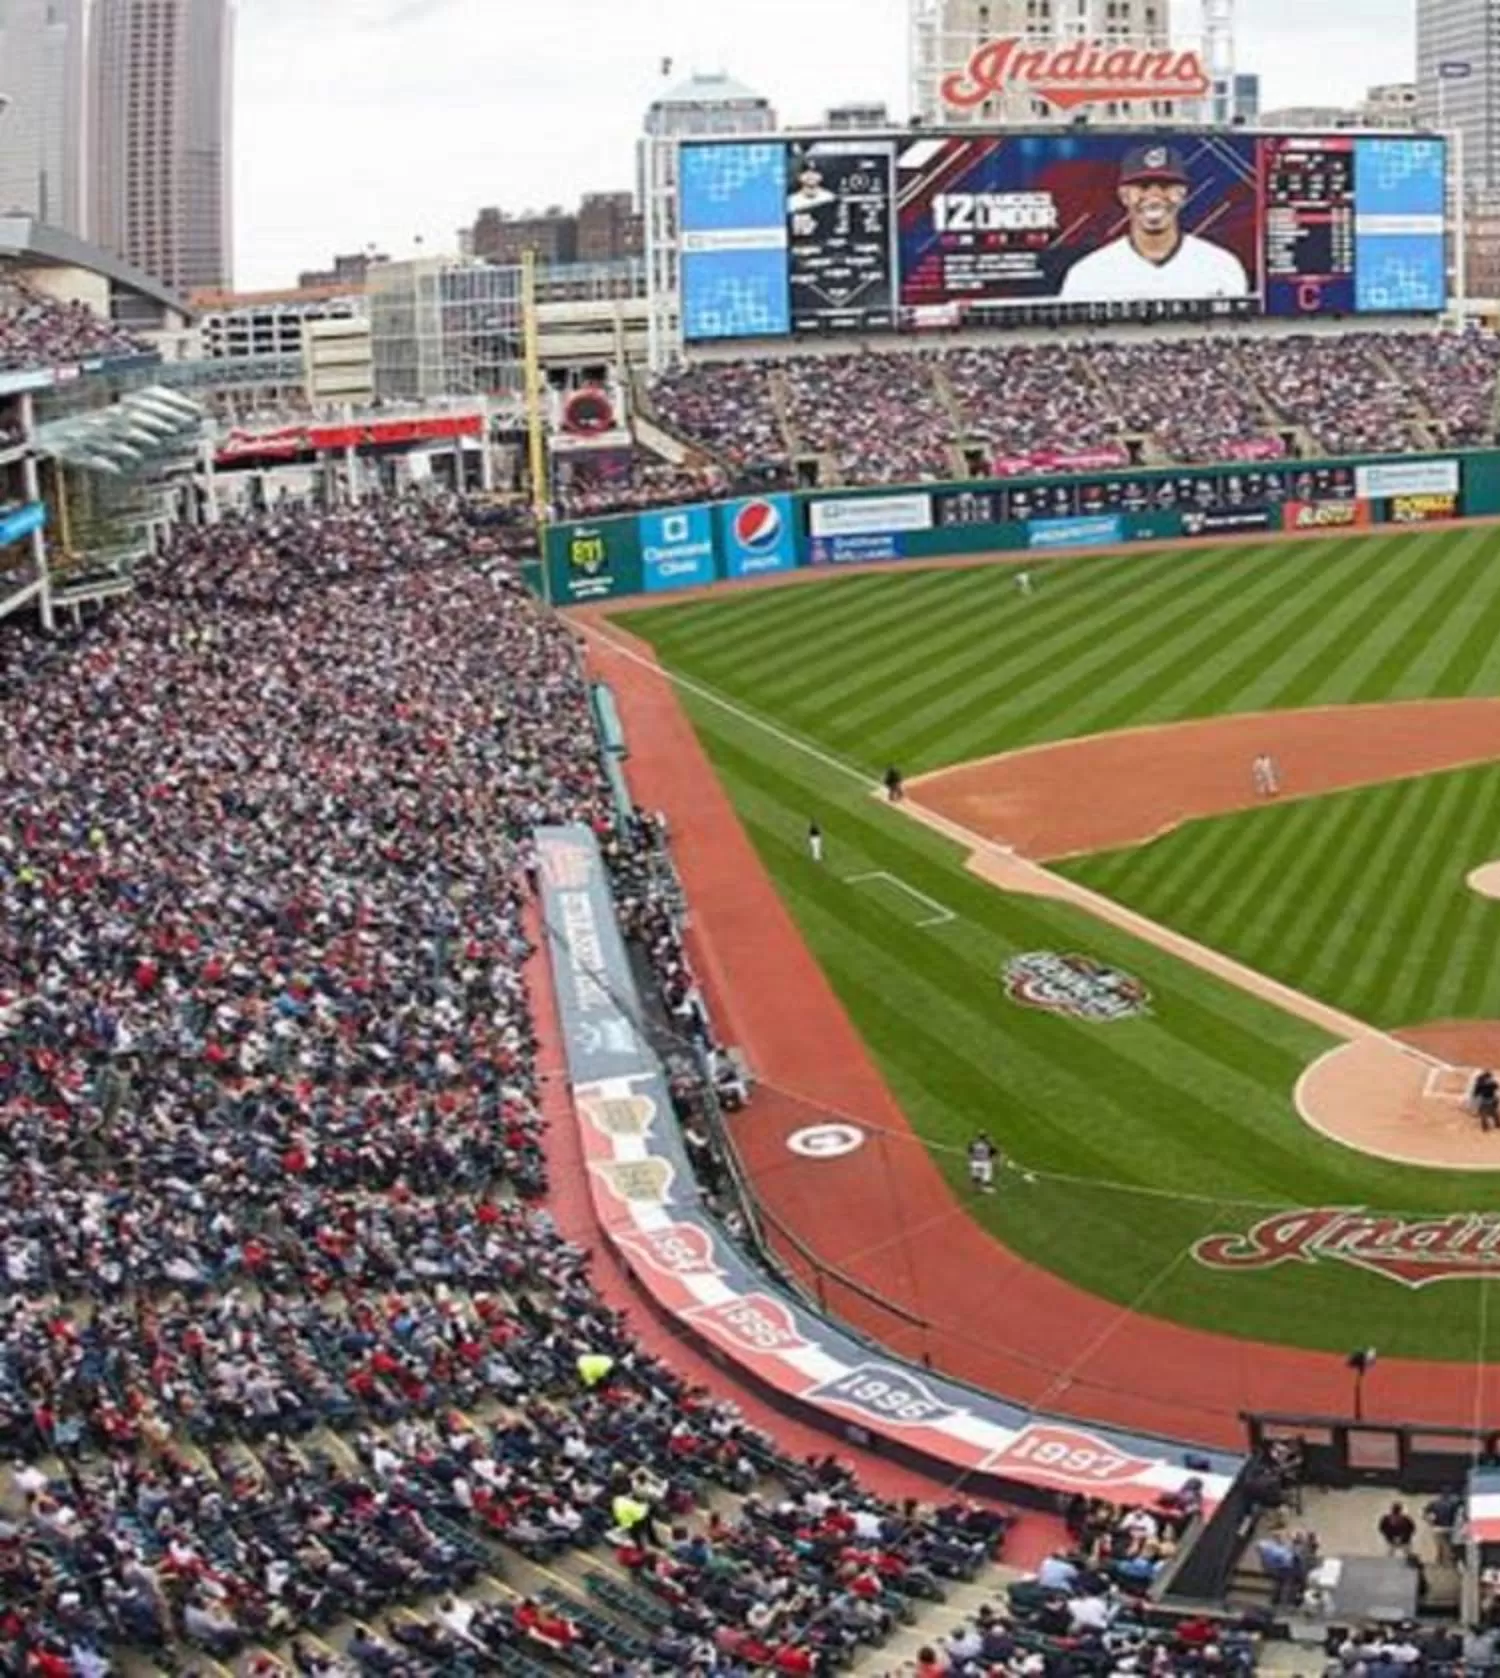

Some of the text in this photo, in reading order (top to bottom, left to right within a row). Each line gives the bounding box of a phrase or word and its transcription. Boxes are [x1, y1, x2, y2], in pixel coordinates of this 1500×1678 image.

[941, 37, 1209, 109] Indians
[932, 193, 975, 231] 12
[838, 1374, 935, 1421] 1996
[1009, 1434, 1128, 1478] 1997
